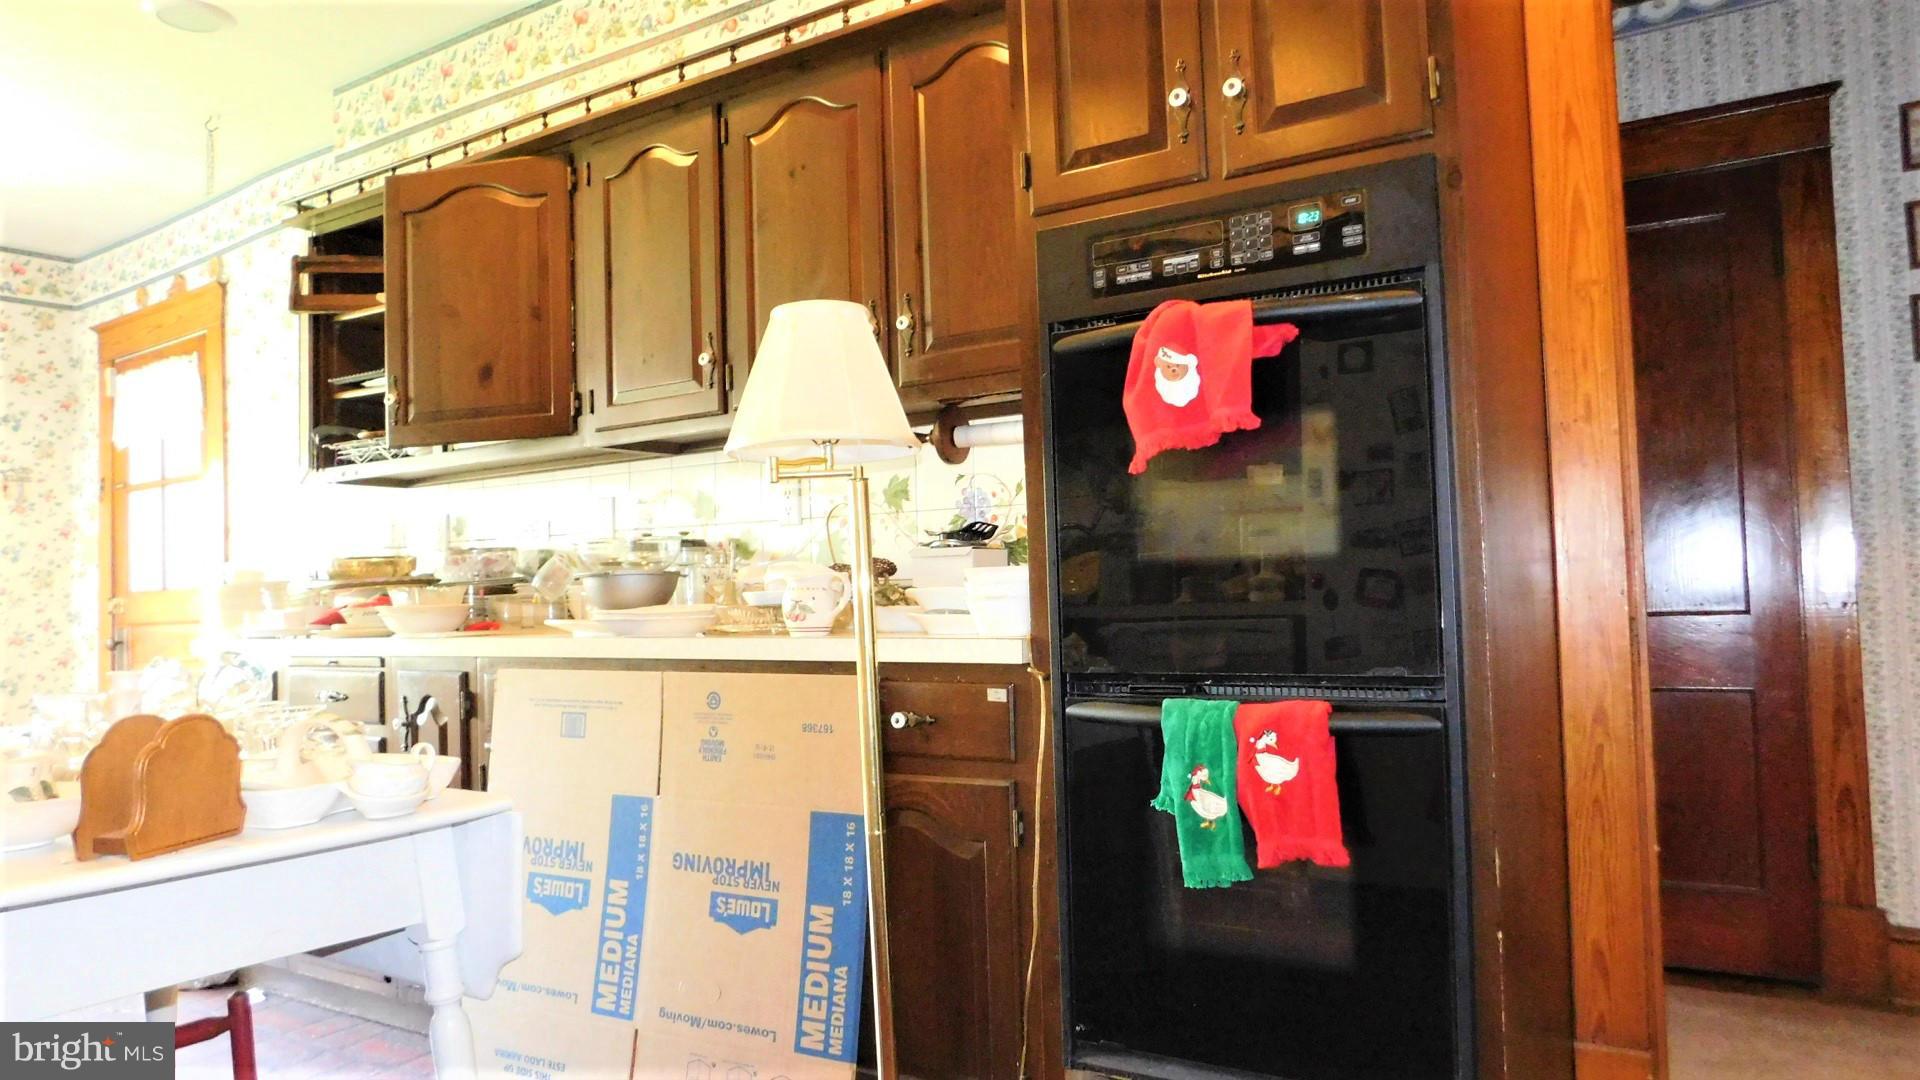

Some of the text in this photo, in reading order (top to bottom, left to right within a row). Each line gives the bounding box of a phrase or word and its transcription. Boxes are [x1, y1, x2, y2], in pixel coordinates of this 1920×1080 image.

[640, 802, 649, 818] 16
[638, 835, 647, 848] 18
[530, 854, 593, 873] NEVER STOP
[635, 865, 644, 880] 18
[672, 852, 770, 880] IMPROVING
[842, 822, 856, 906] 18 X 18 X 16
[533, 876, 584, 904] LOWE'S
[712, 873, 781, 893] NEVER STOP
[716, 896, 771, 923] LOWE'S
[595, 879, 629, 1012] MEDIUM
[619, 934, 639, 1015] MEDIANA
[800, 904, 834, 1051] MEDIUM
[658, 1006, 777, 1043] Lowes.com/Moving
[828, 966, 849, 1056] MEDIANA
[523, 1055, 546, 1068] LADO
[548, 1060, 566, 1073] ESTE
